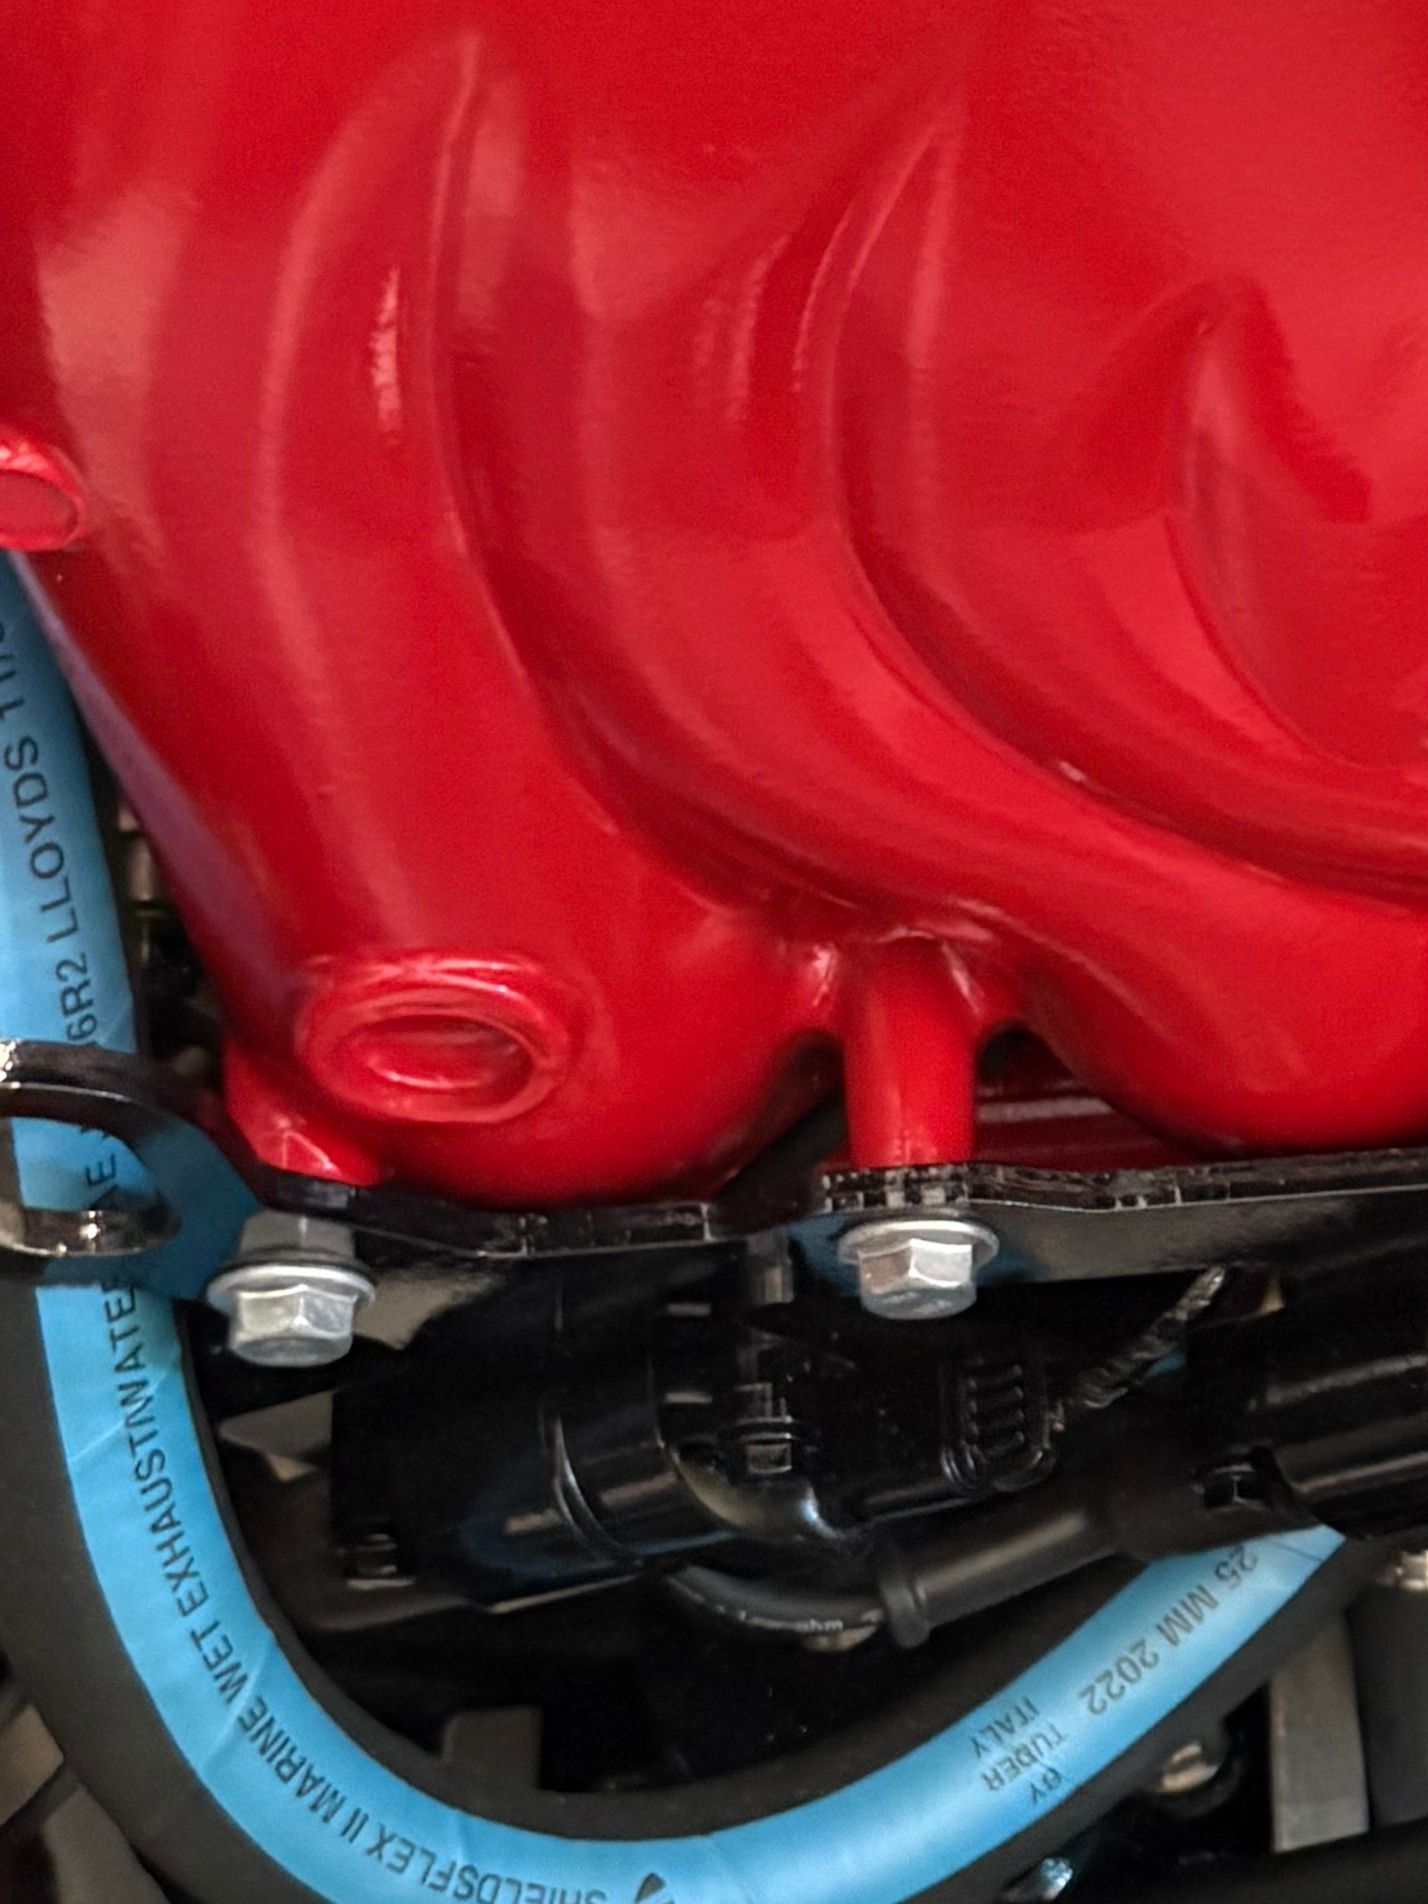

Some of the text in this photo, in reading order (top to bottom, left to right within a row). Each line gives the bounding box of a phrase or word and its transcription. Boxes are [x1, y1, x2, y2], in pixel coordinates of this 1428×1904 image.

[4, 735, 79, 944] LLOYDS
[189, 1619, 249, 1705] WET
[1077, 1544, 1259, 1717] 25 MM 2022
[236, 1695, 347, 1825] MARINE
[969, 1697, 1041, 1759] ITALY
